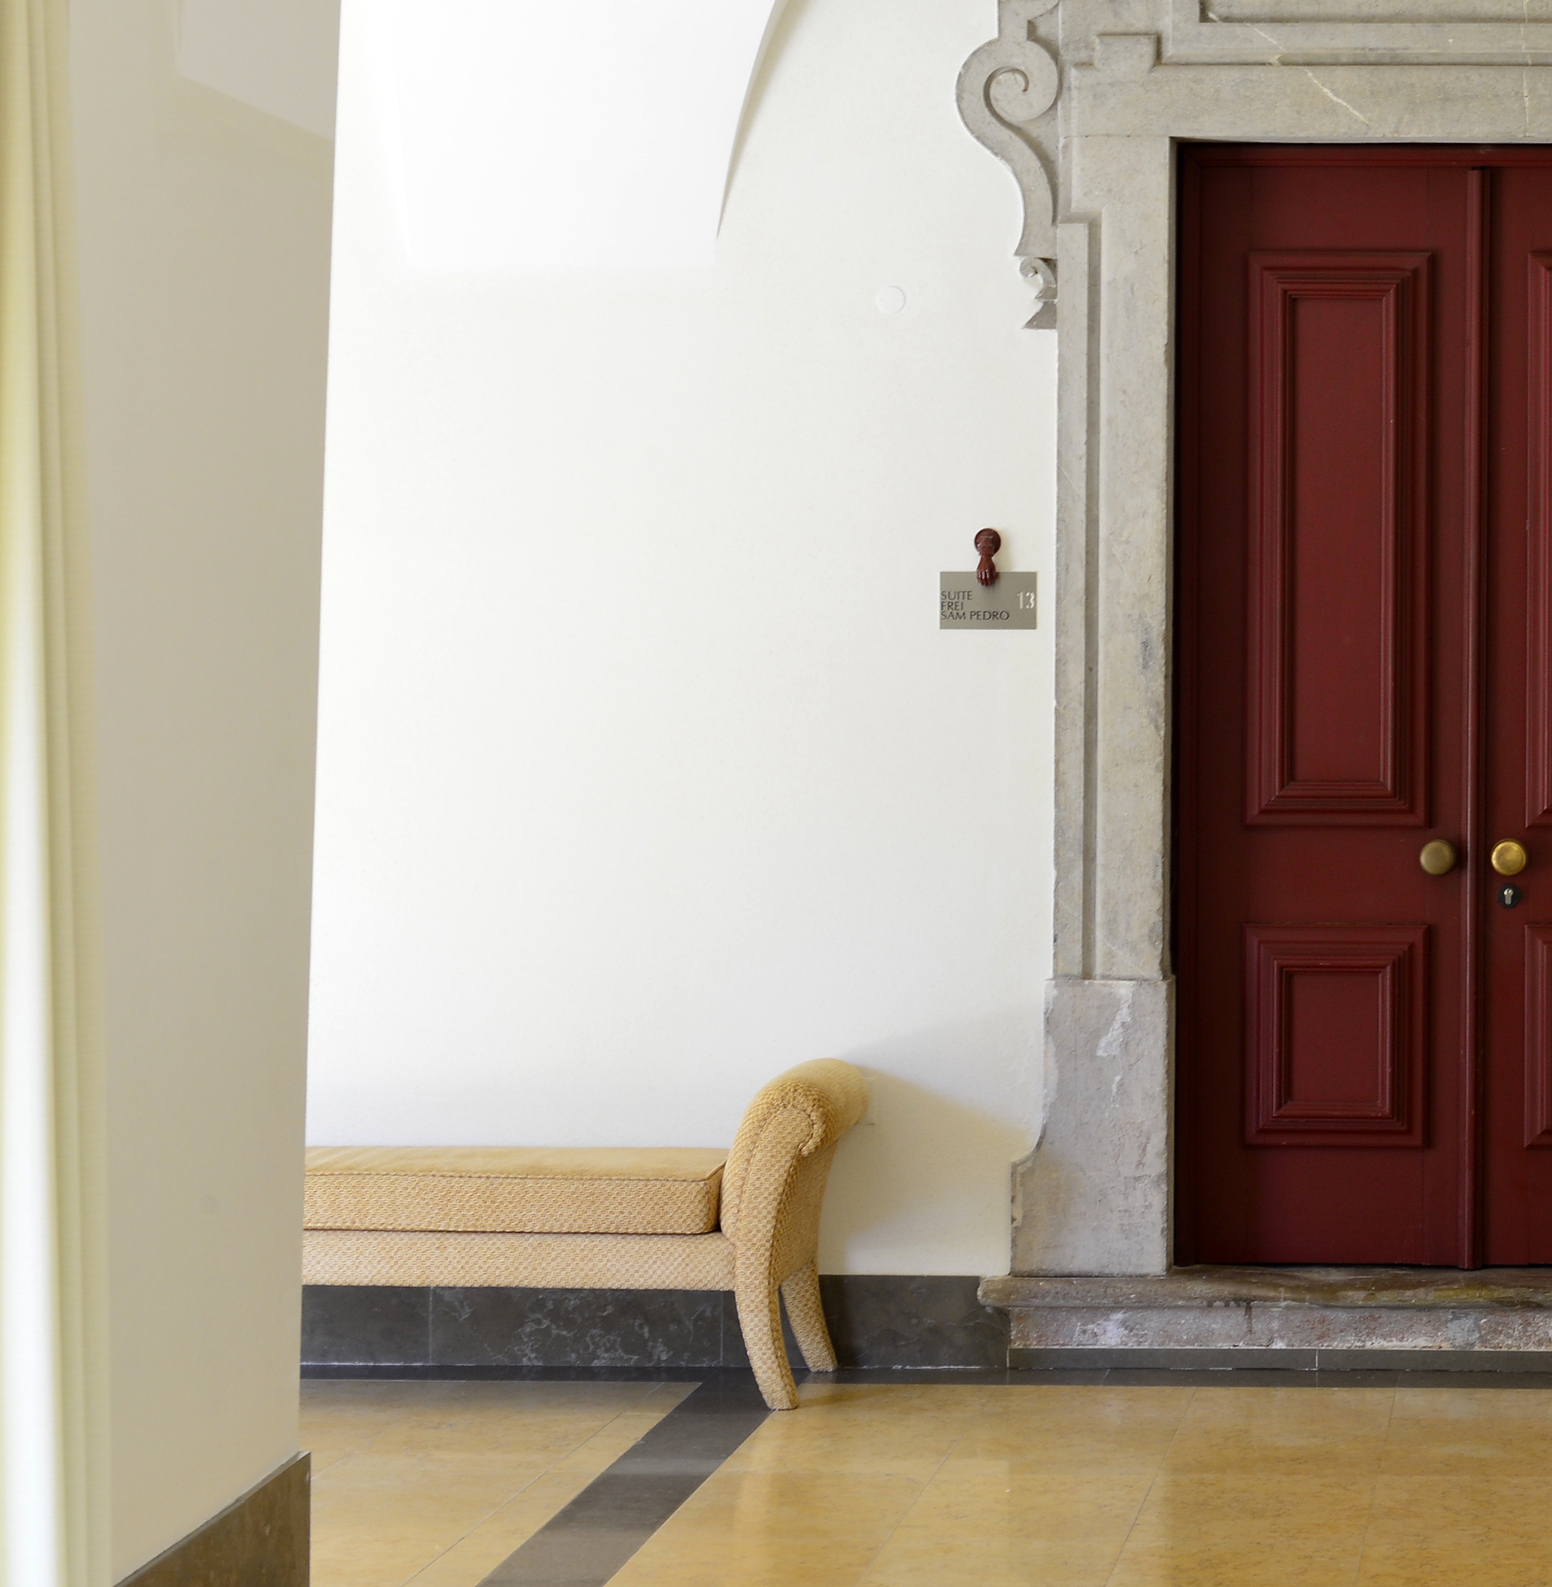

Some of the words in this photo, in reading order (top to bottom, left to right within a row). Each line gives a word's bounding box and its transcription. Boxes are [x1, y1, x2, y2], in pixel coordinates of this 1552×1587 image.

[941, 591, 973, 600] SUITE
[1017, 591, 1035, 610] 13
[941, 601, 964, 611] FREI
[941, 611, 966, 620] SAM
[969, 611, 1010, 620] PEDRO
